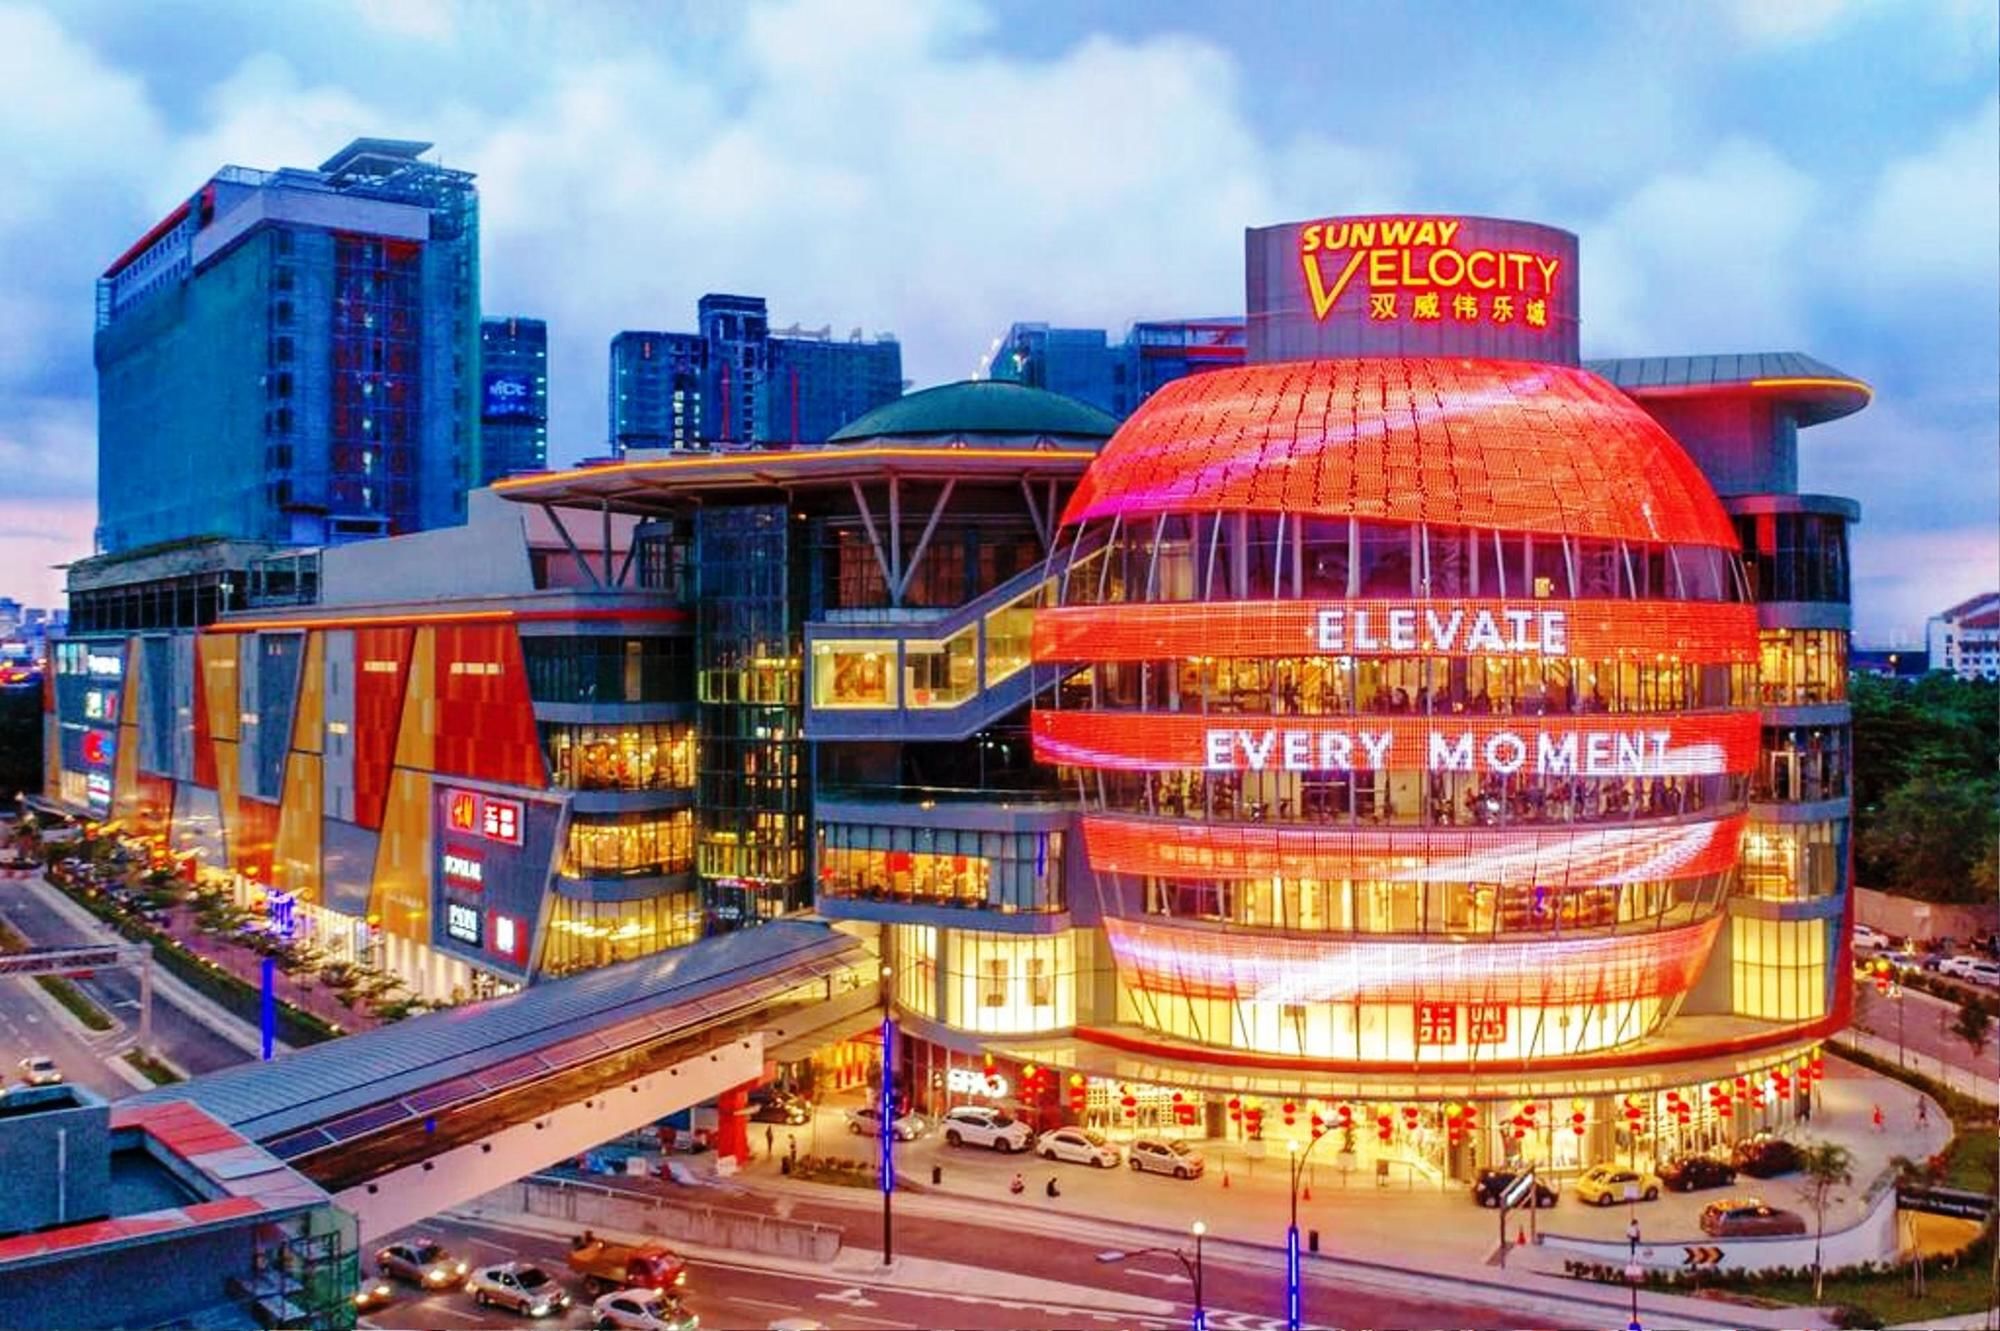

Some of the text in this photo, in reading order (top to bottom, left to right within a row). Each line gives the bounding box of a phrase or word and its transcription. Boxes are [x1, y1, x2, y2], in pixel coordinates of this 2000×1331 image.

[1303, 221, 1459, 251] SUNWAY
[1303, 249, 1559, 320] VELOCITY
[1371, 292, 1547, 327] 双威伟乐城
[1315, 608, 1567, 656] ELEVATE
[1206, 728, 1671, 775] EVERY MOMENT
[1471, 1006, 1501, 1022] UNI
